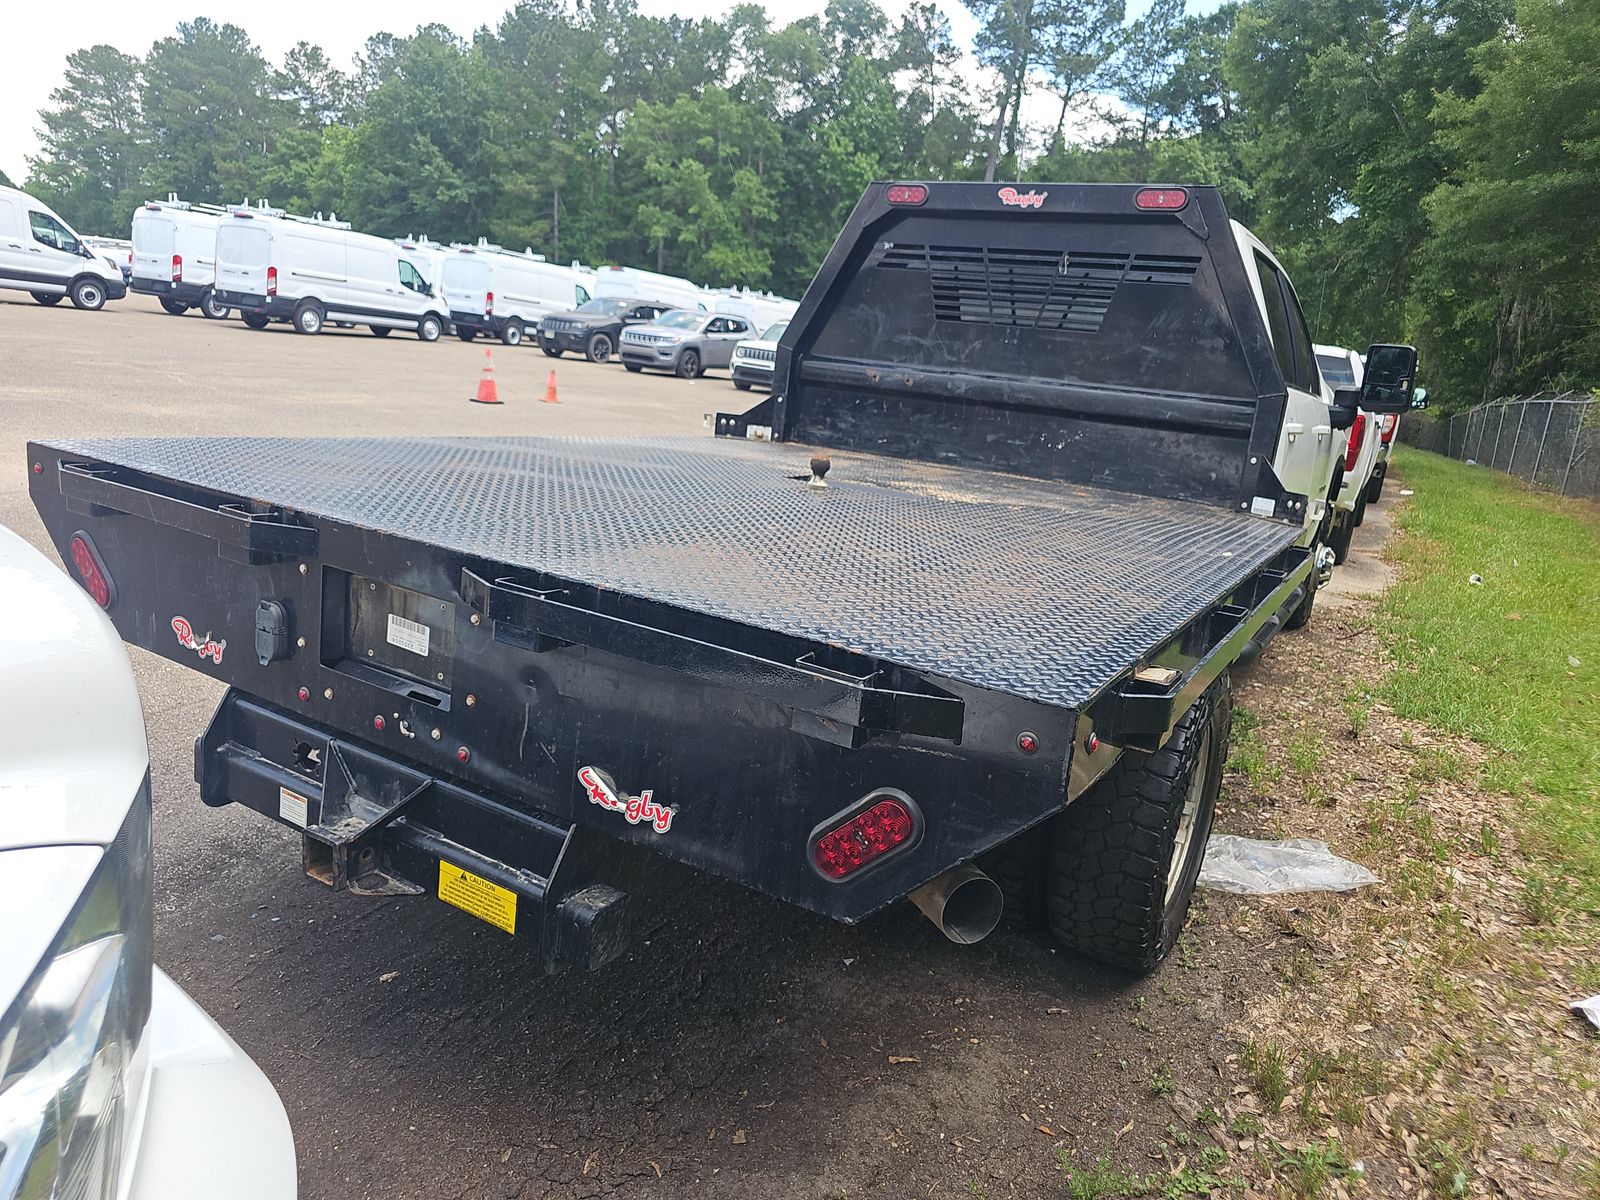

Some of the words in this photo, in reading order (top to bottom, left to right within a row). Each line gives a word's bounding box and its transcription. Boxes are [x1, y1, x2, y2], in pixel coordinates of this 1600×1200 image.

[998, 187, 1047, 208] Rugby
[578, 767, 675, 833] Rgby
[469, 875, 496, 892] CAUTION
